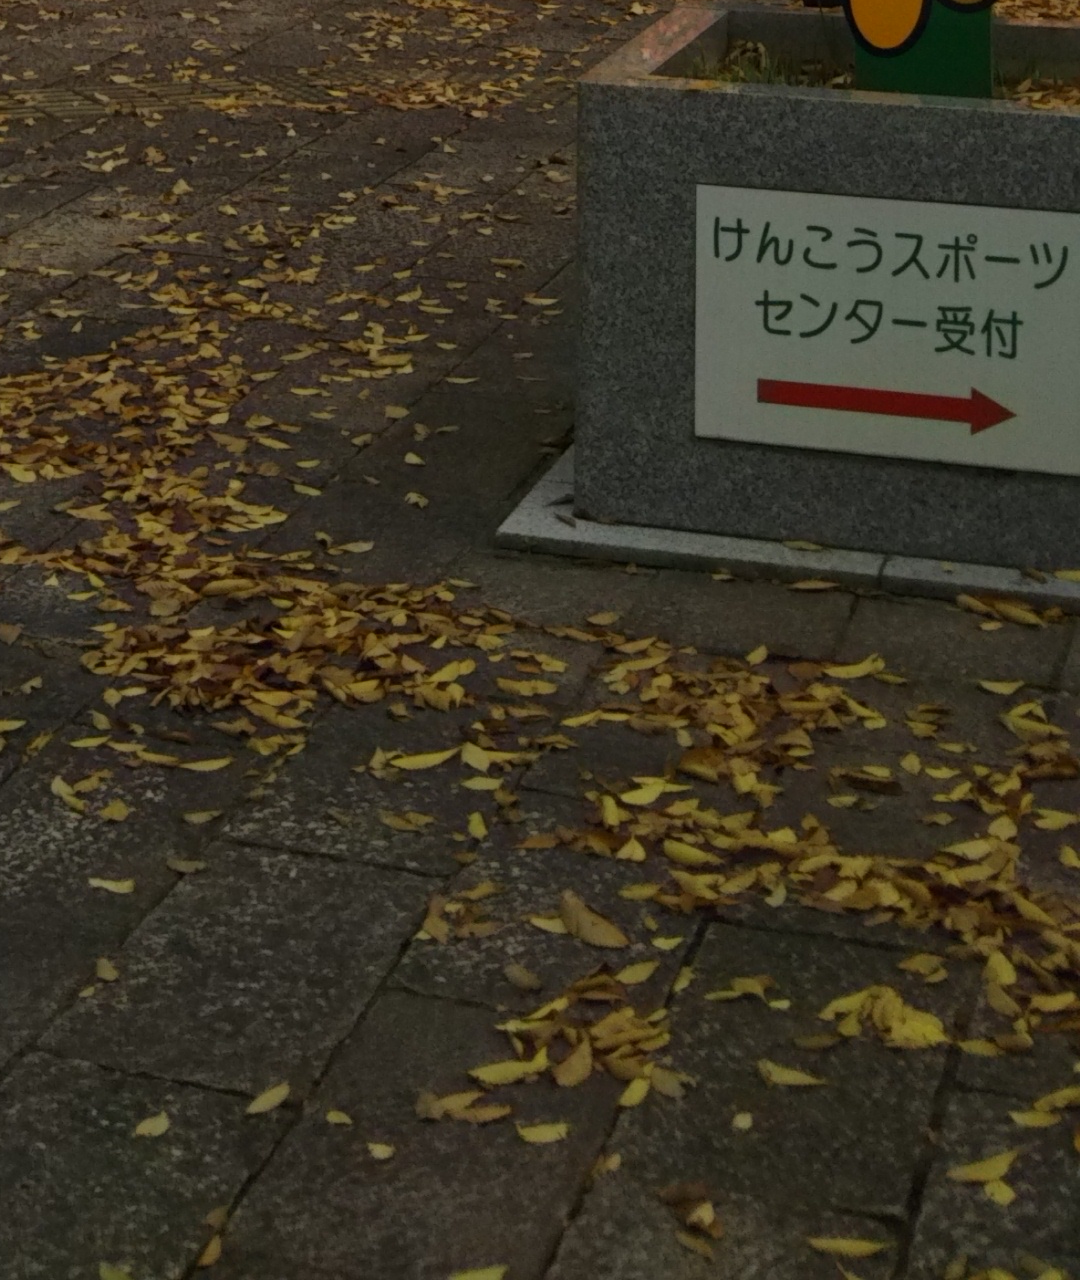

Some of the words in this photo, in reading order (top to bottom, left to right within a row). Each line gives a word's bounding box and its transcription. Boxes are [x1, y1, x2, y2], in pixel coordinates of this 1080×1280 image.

[713, 216, 1069, 289] けんこうスポーツ
[754, 289, 1024, 360] センター受付
